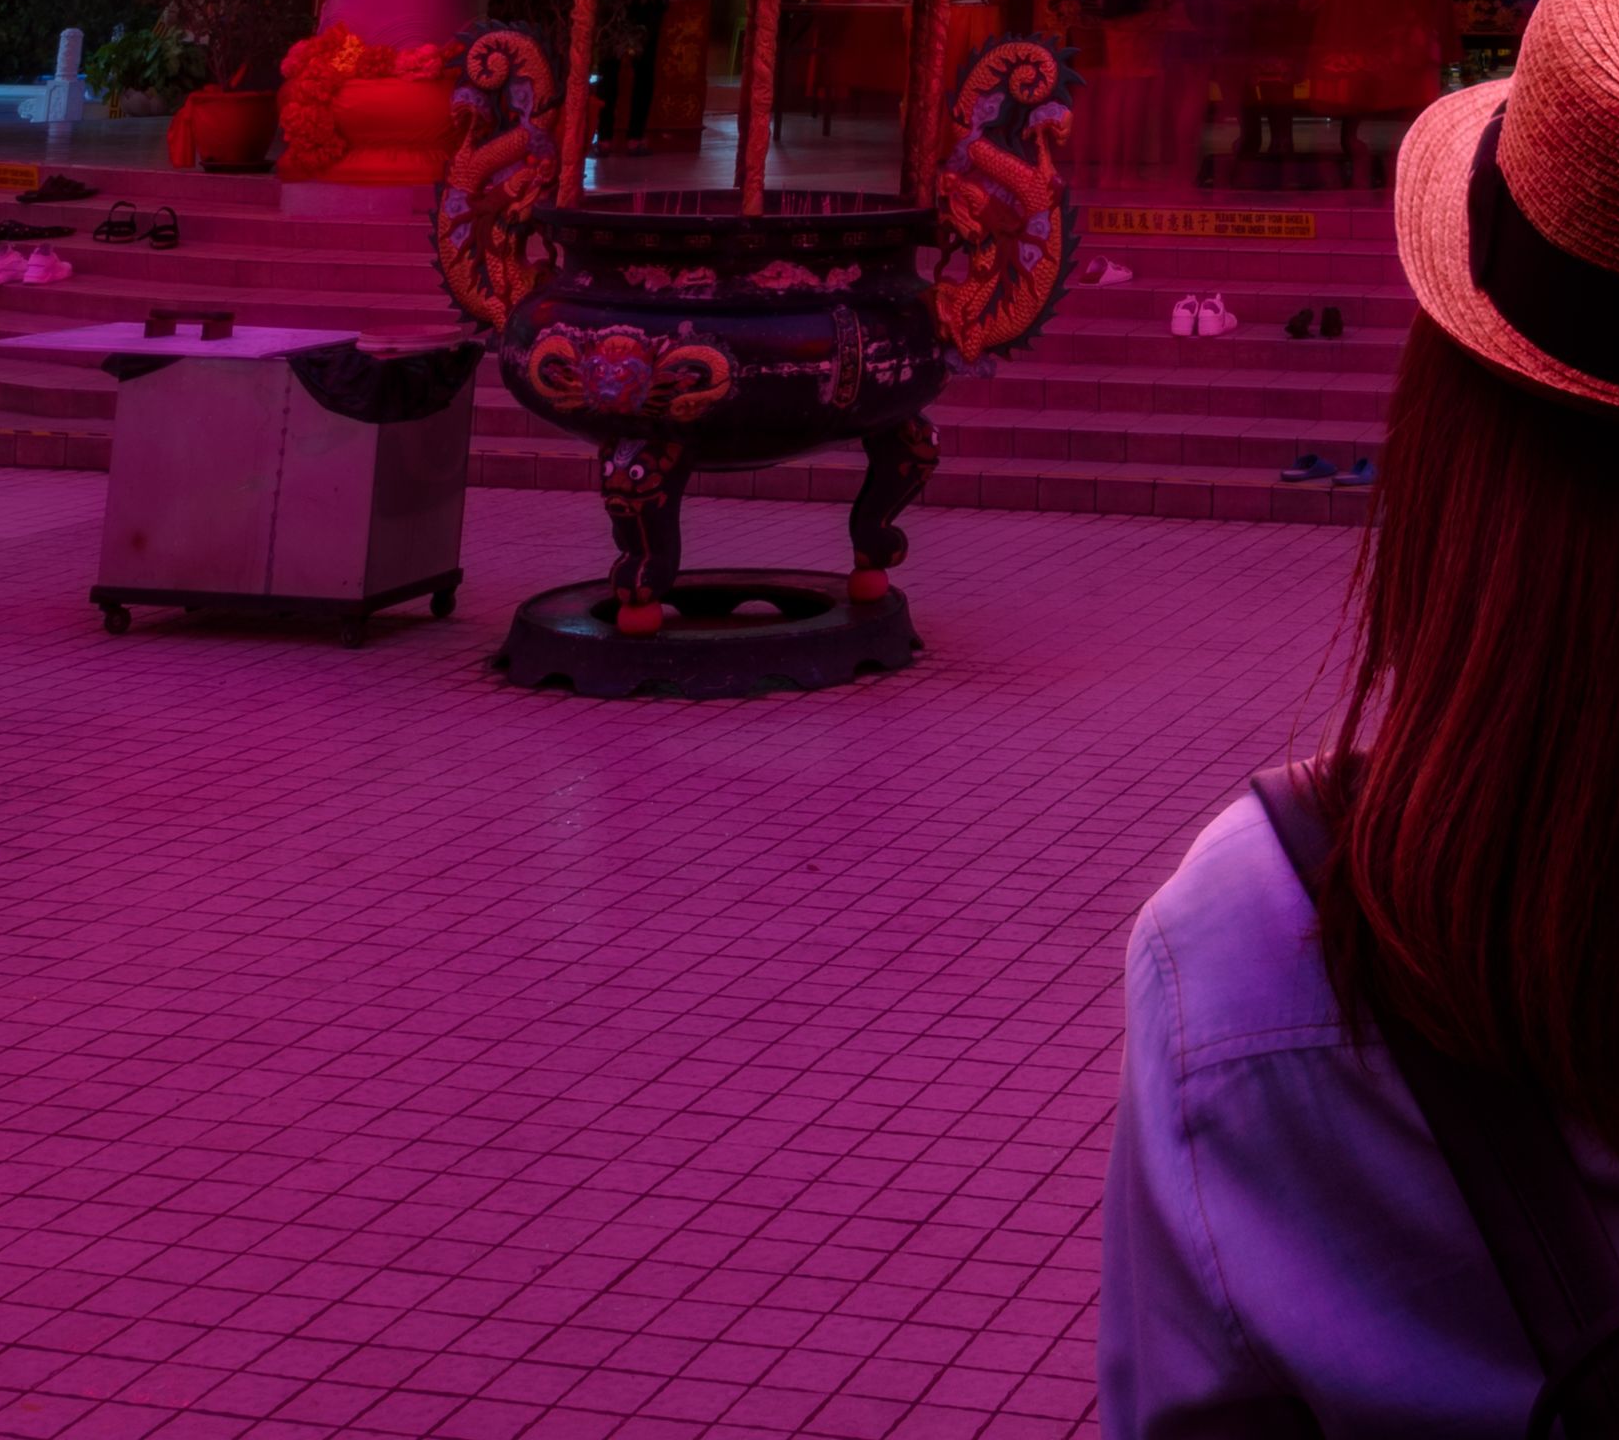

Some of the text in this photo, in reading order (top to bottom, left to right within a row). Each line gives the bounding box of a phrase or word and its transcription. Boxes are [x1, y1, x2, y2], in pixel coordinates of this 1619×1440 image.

[1215, 213, 1236, 223] PLEASE
[1238, 213, 1252, 223] TAKE
[1255, 214, 1266, 223] OFF
[1268, 214, 1282, 224] YOUR
[1285, 215, 1303, 224] SHOES
[1268, 225, 1282, 235] YOUR
